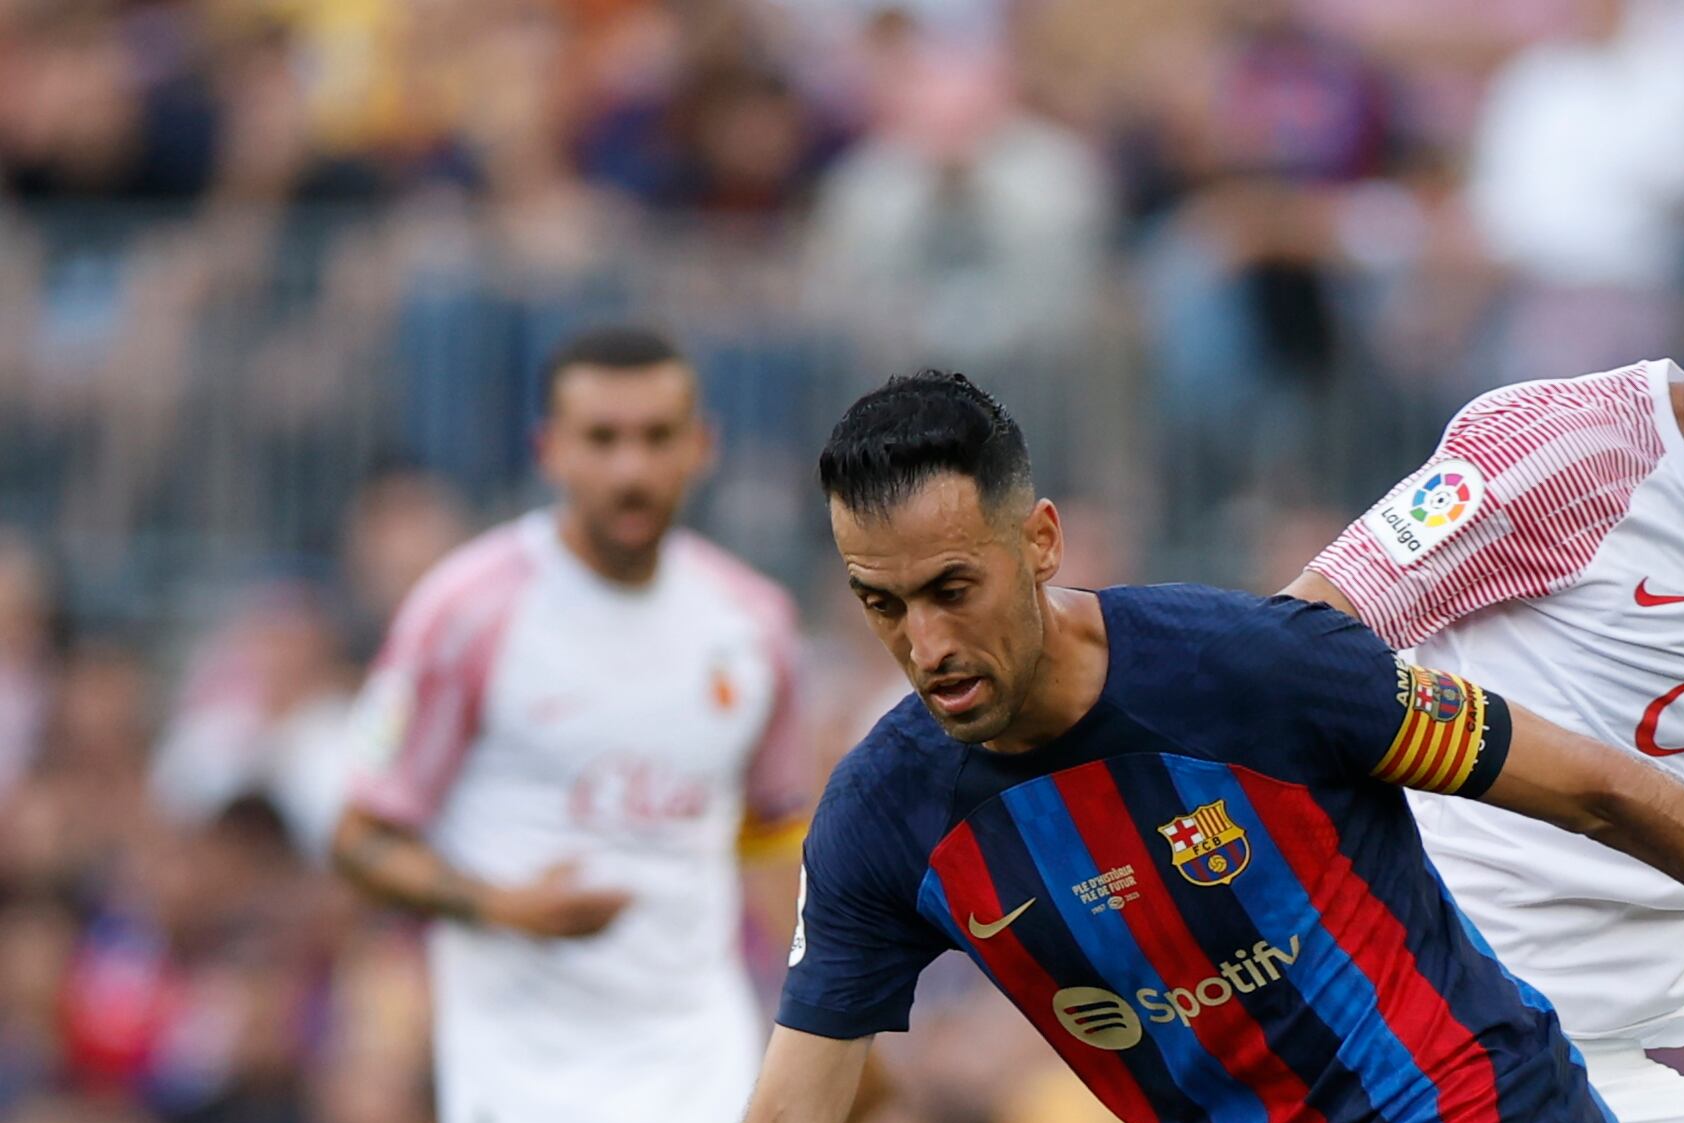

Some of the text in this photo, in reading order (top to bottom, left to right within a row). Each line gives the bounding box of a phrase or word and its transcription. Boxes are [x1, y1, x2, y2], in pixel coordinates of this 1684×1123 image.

[1381, 506, 1421, 551] LaLiga
[1192, 836, 1222, 855] FCB
[1072, 881, 1090, 896] PLE
[1080, 875, 1137, 904] PLE DE FUTUR
[1136, 934, 1300, 1027] Spotify
